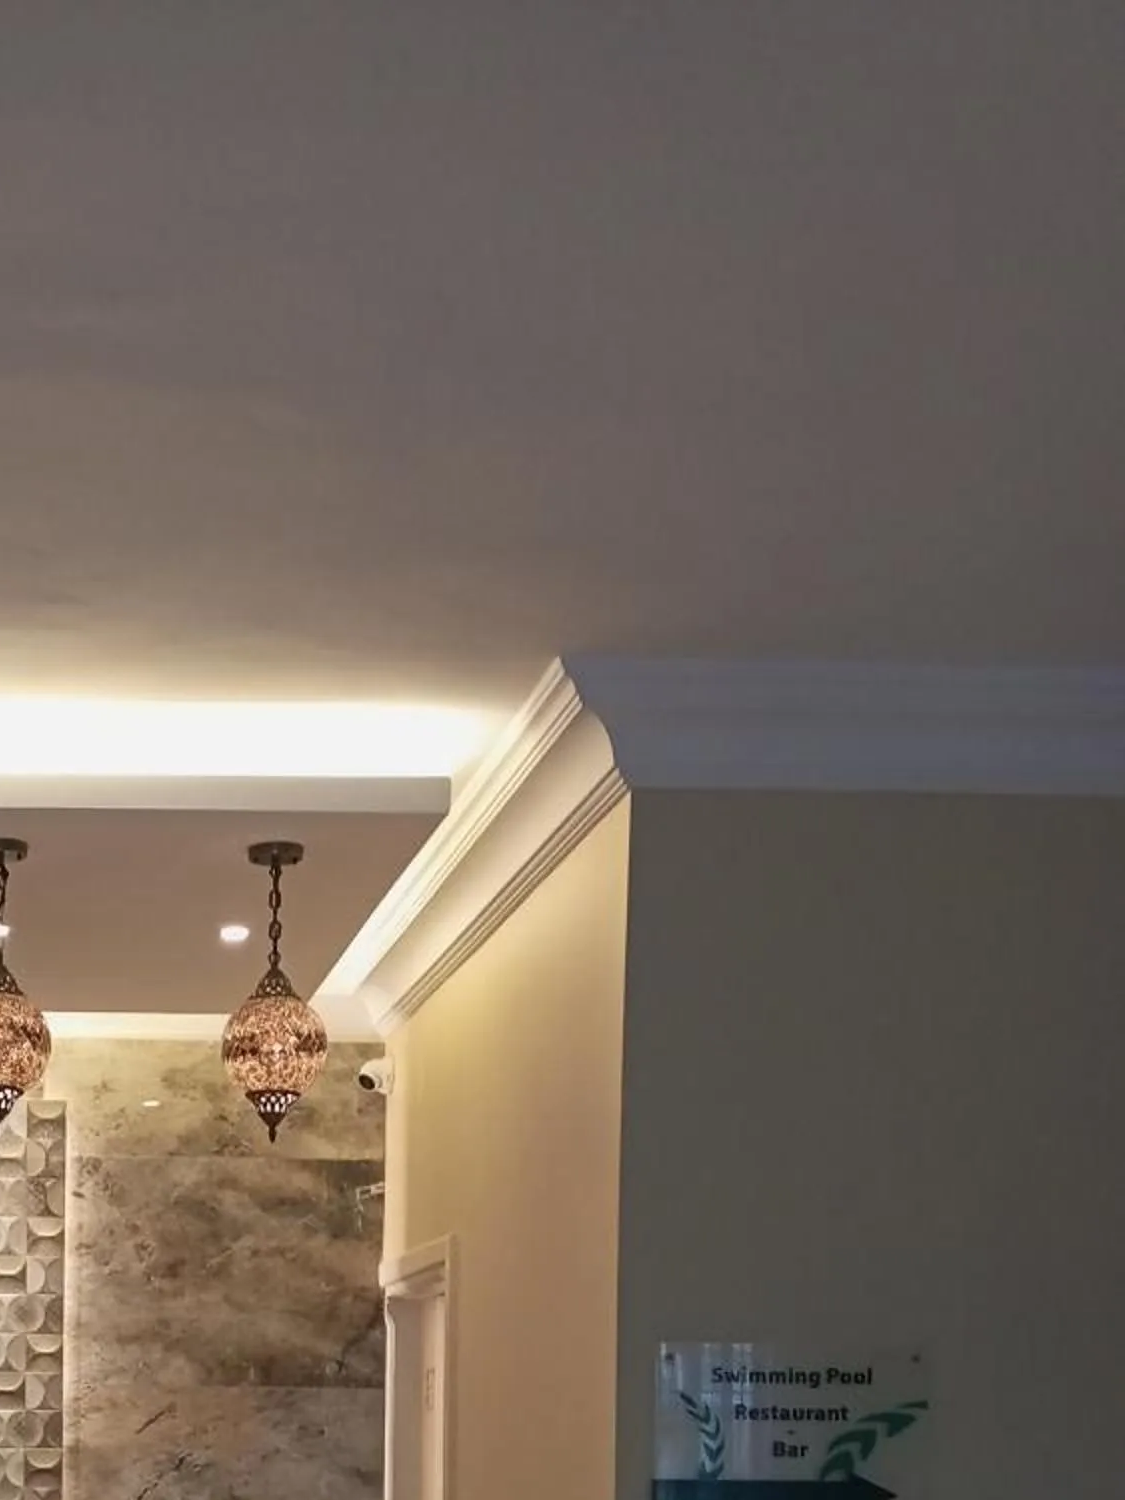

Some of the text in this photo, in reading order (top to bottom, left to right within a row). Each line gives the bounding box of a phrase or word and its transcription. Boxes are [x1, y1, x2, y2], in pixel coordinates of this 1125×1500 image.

[711, 1366, 873, 1388] Swimming Pool
[734, 1404, 850, 1421] Restaurant
[772, 1441, 809, 1457] Bar
